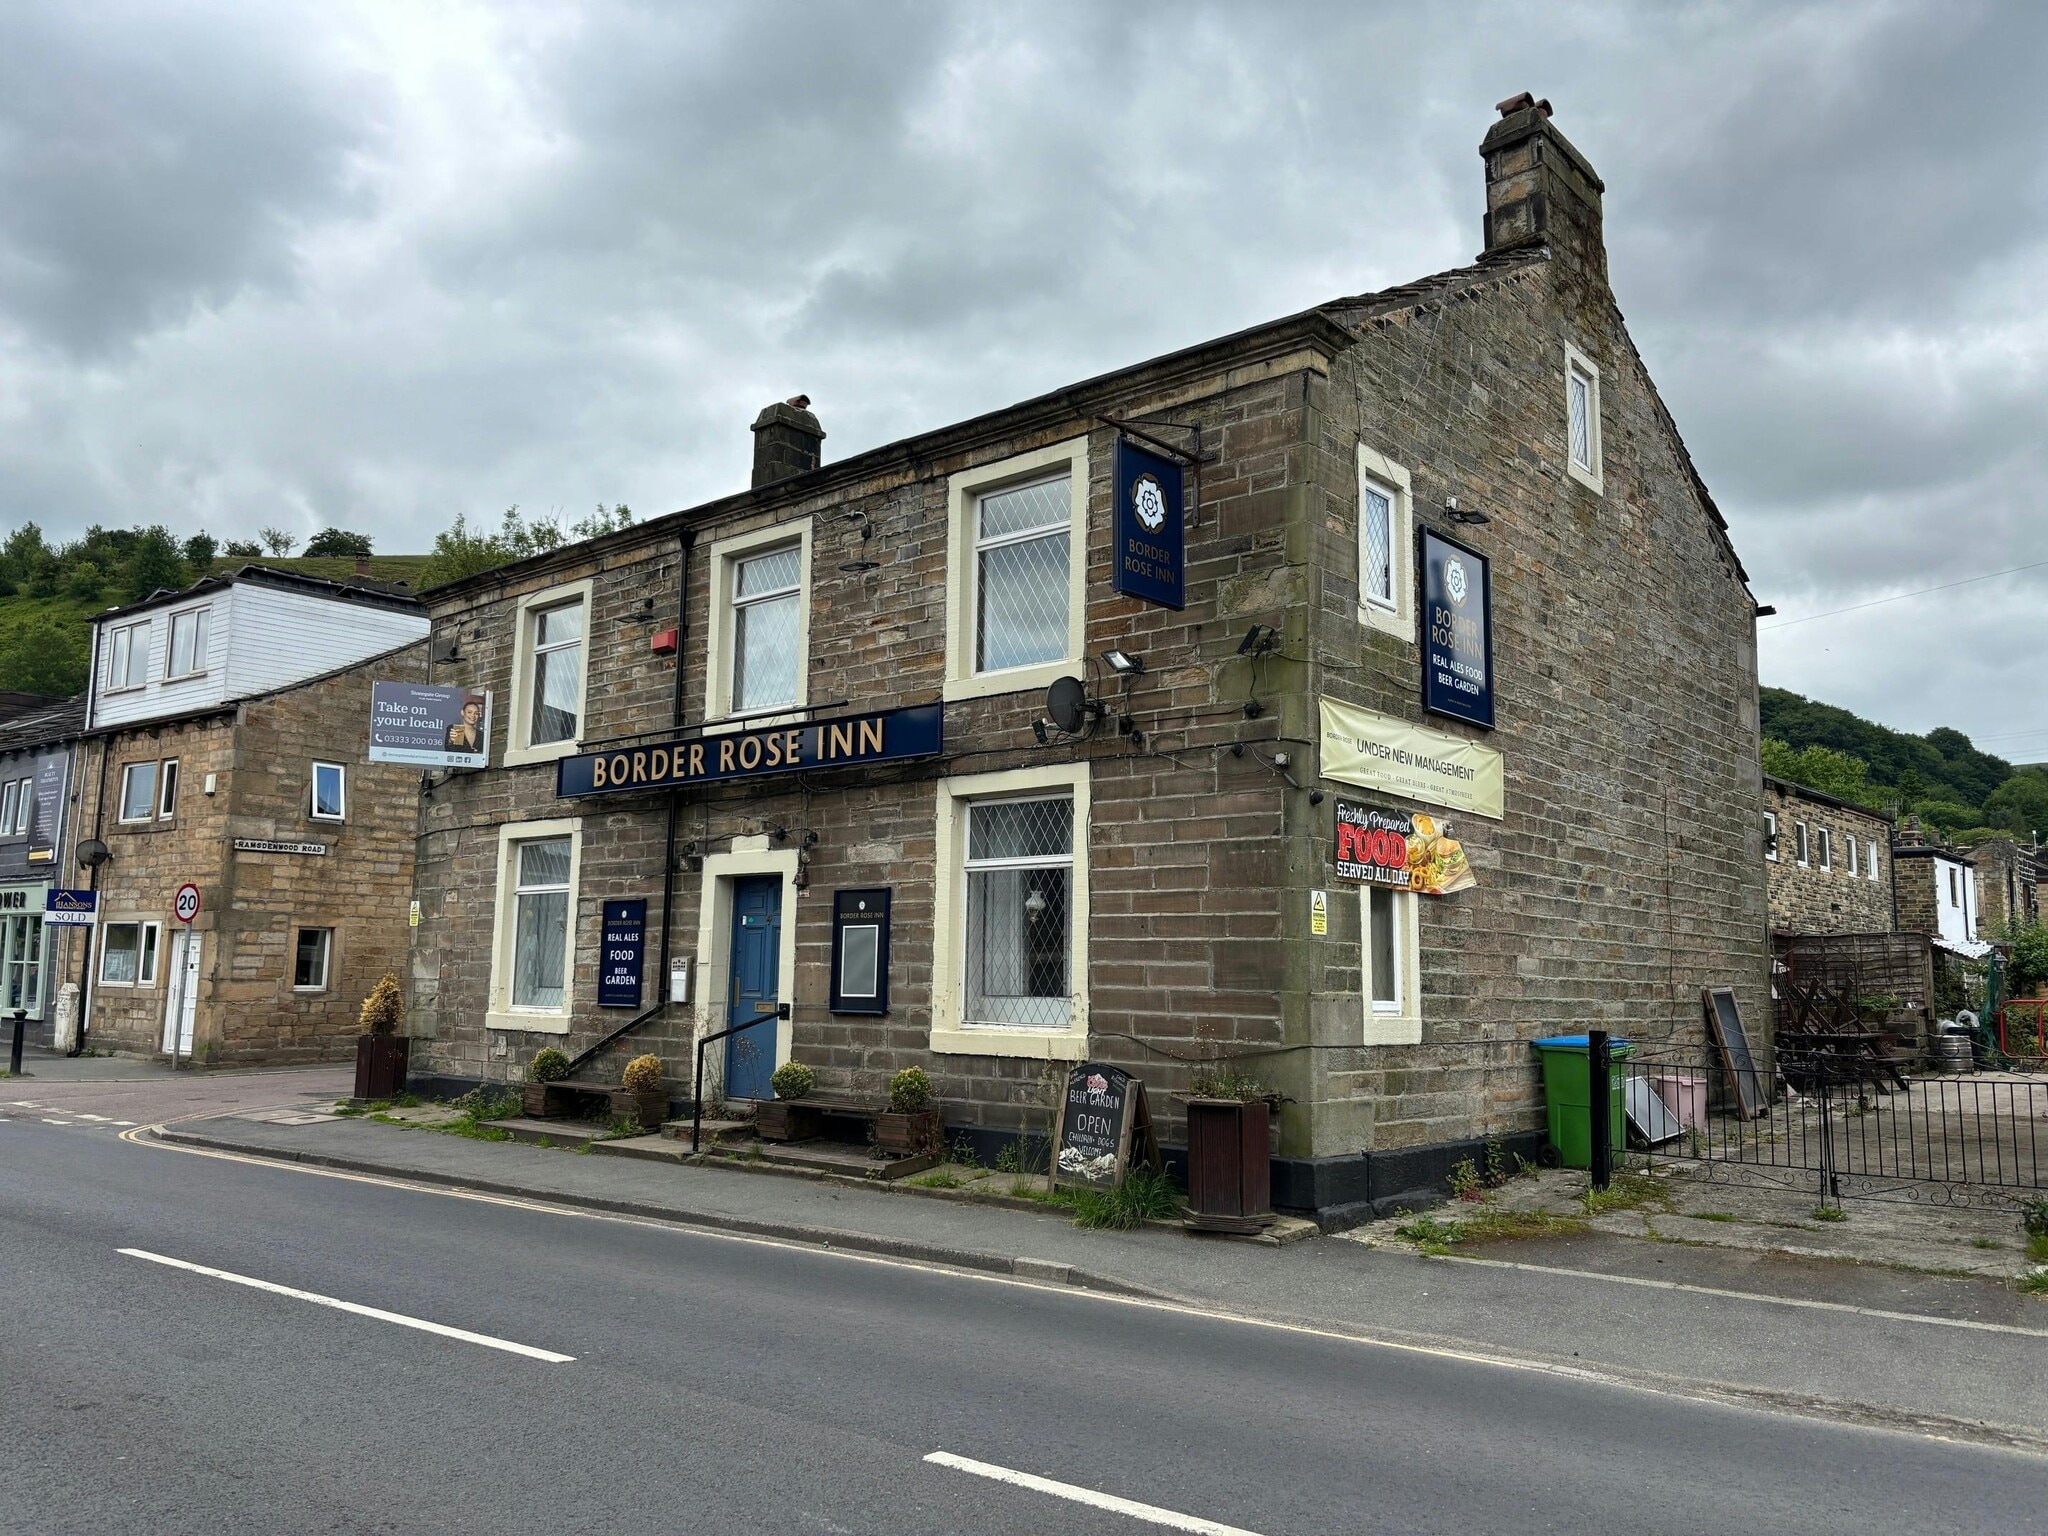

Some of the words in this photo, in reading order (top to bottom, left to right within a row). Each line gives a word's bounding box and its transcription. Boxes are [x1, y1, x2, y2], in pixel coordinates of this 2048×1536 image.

[1129, 538, 1170, 565] BORDER
[1125, 556, 1153, 577] ROSE
[1155, 565, 1175, 585] INN
[1435, 606, 1478, 639] BORDER
[1432, 624, 1460, 651] ROSE
[1463, 637, 1483, 660] INN
[1432, 653, 1449, 669] REAL
[1449, 660, 1465, 674] ALES
[1465, 665, 1483, 681] FOOD
[1438, 672, 1453, 687] BEER
[1454, 678, 1480, 696] GARDEN
[377, 701, 409, 714] Take
[411, 705, 427, 715] on
[376, 716, 407, 727] your
[409, 717, 444, 730] local!
[384, 735, 410, 744] 03333
[411, 735, 427, 745] 200
[427, 737, 443, 746] 036
[593, 743, 705, 788] BORDER
[719, 732, 801, 773] ROSE
[817, 717, 883, 760] INN
[1356, 738, 1391, 760] UNDER
[1392, 748, 1413, 766] NEW
[1415, 754, 1475, 782] MANAGEMENT
[1359, 766, 1376, 777] GREAT
[1395, 776, 1411, 786] GREAT
[1430, 784, 1444, 793] GREAT
[1369, 810, 1411, 835] Prepared
[238, 841, 298, 851] RAMSDENWOOD
[301, 844, 322, 853] ROAD
[1337, 822, 1407, 869] FOOD
[1337, 861, 1374, 880] SERVED
[1375, 866, 1391, 883] ALL
[1392, 869, 1409, 885] DAY
[178, 895, 197, 910] 20
[55, 912, 86, 922] SOLD
[607, 933, 622, 942] REAL
[623, 933, 639, 942] ALES
[610, 950, 634, 960] FOOD
[605, 975, 636, 985] GARDEN
[614, 967, 627, 975] BEER
[1069, 1089, 1087, 1105] BEER
[1089, 1092, 1120, 1109] GARDEN
[1077, 1113, 1112, 1136] OPEN
[1097, 1136, 1115, 1148] DOGS
